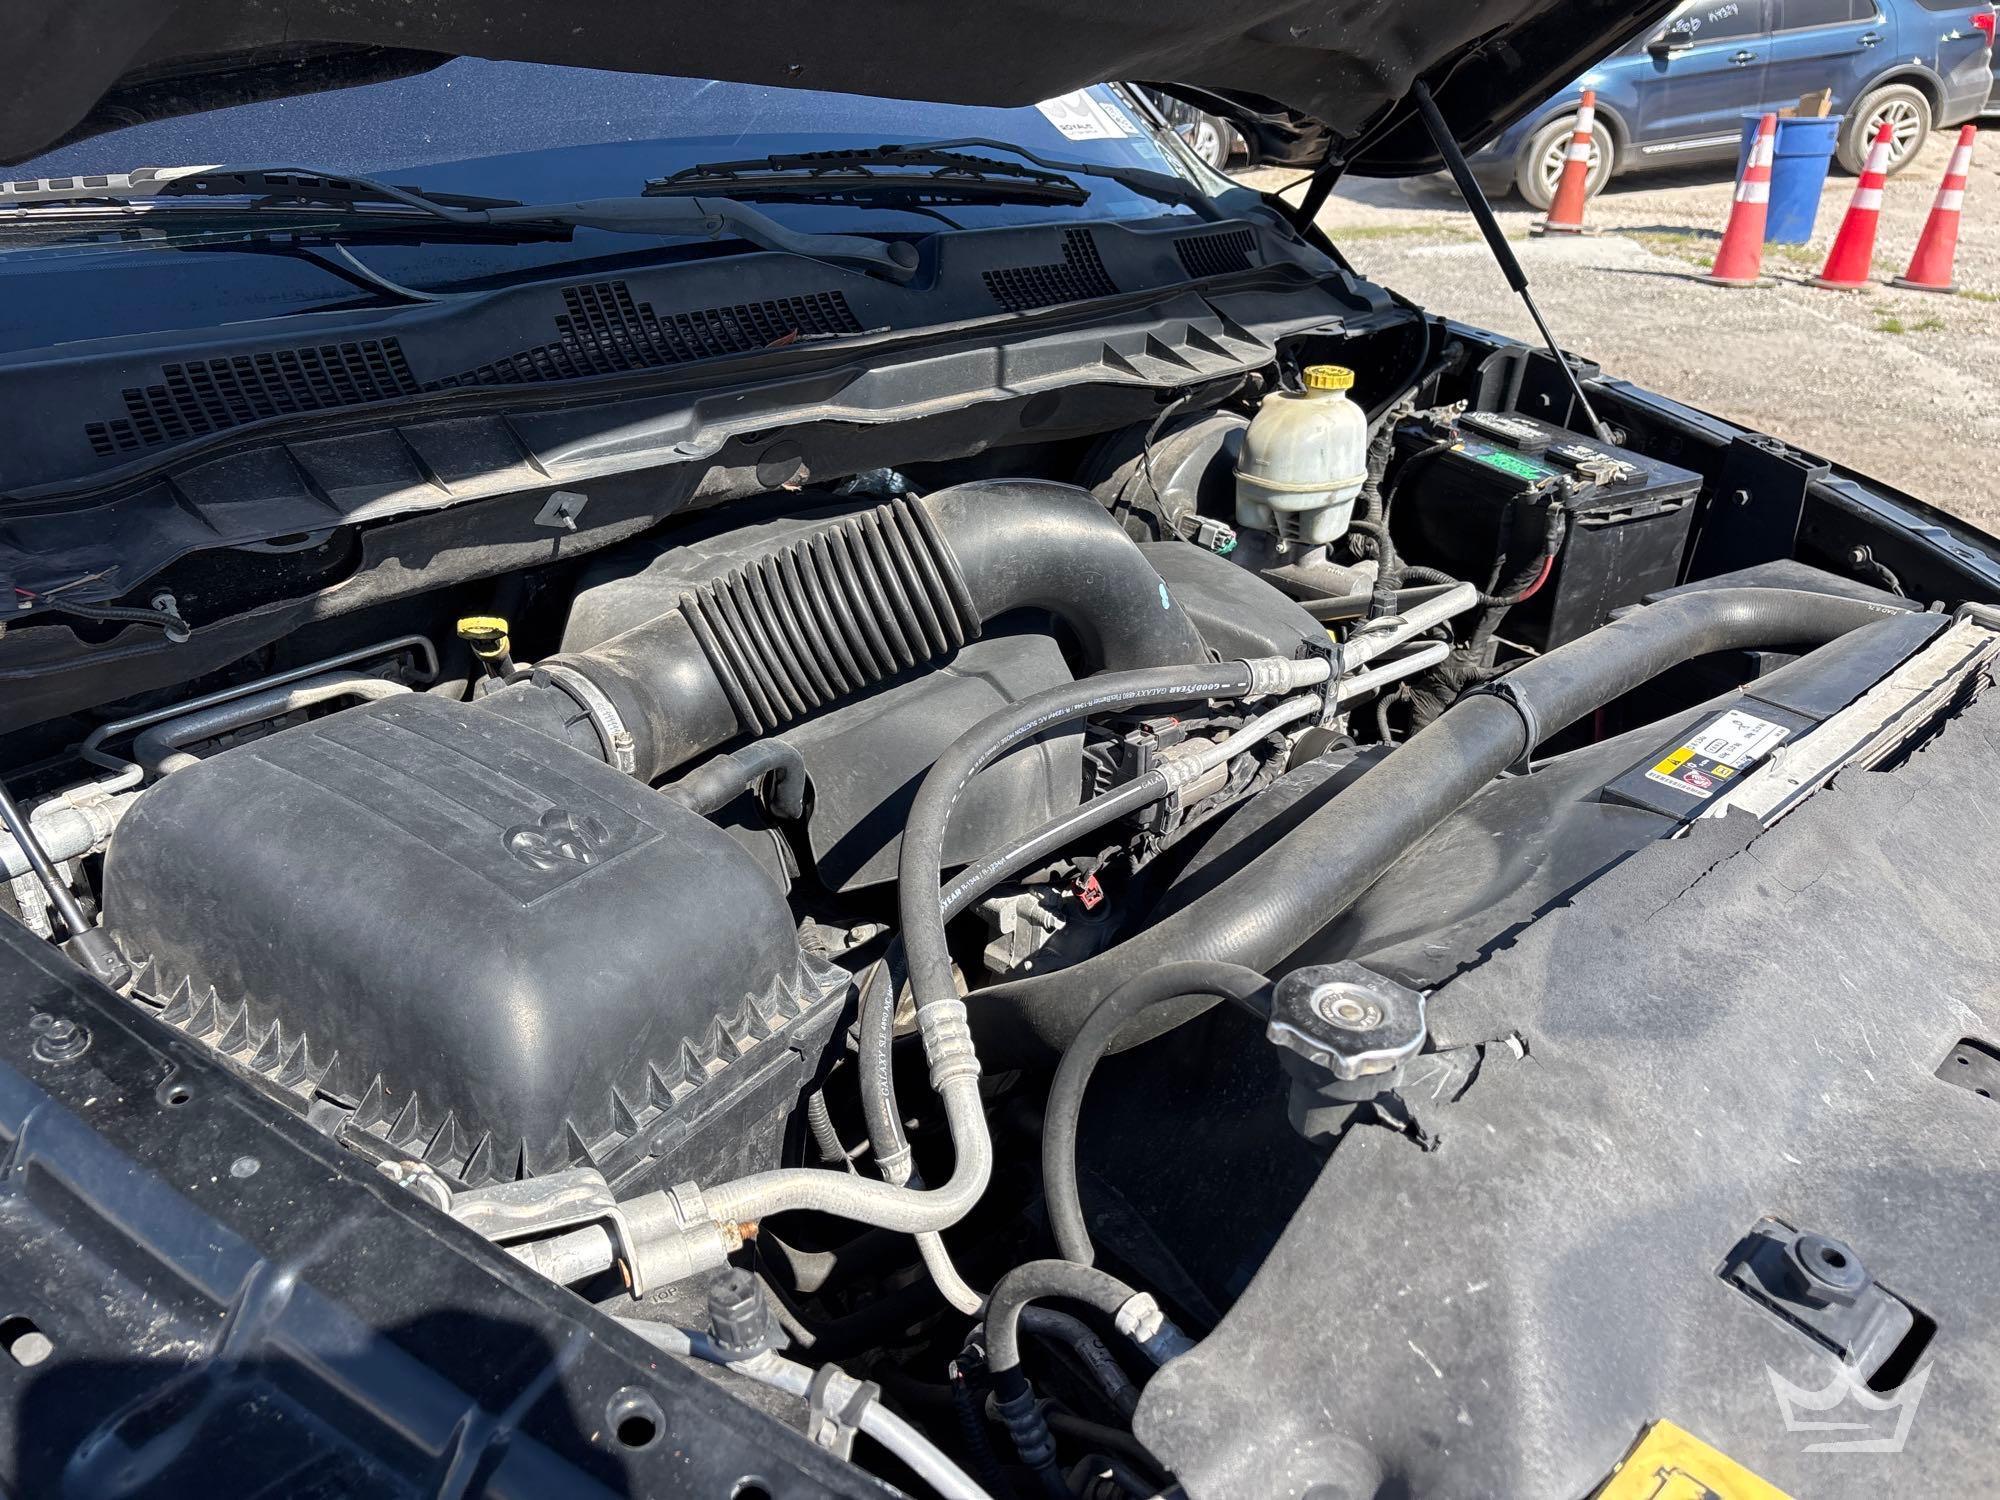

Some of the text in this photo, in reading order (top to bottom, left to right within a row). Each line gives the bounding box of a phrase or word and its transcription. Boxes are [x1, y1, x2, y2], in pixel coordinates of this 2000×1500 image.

[1136, 687, 1167, 697] GALAXY
[1169, 683, 1220, 694] GOODYEAR
[1014, 720, 1038, 736] SUCTION
[1000, 732, 1015, 746] HOSE
[878, 1049, 890, 1097] GALAXY
[650, 1287, 677, 1303] TOP
